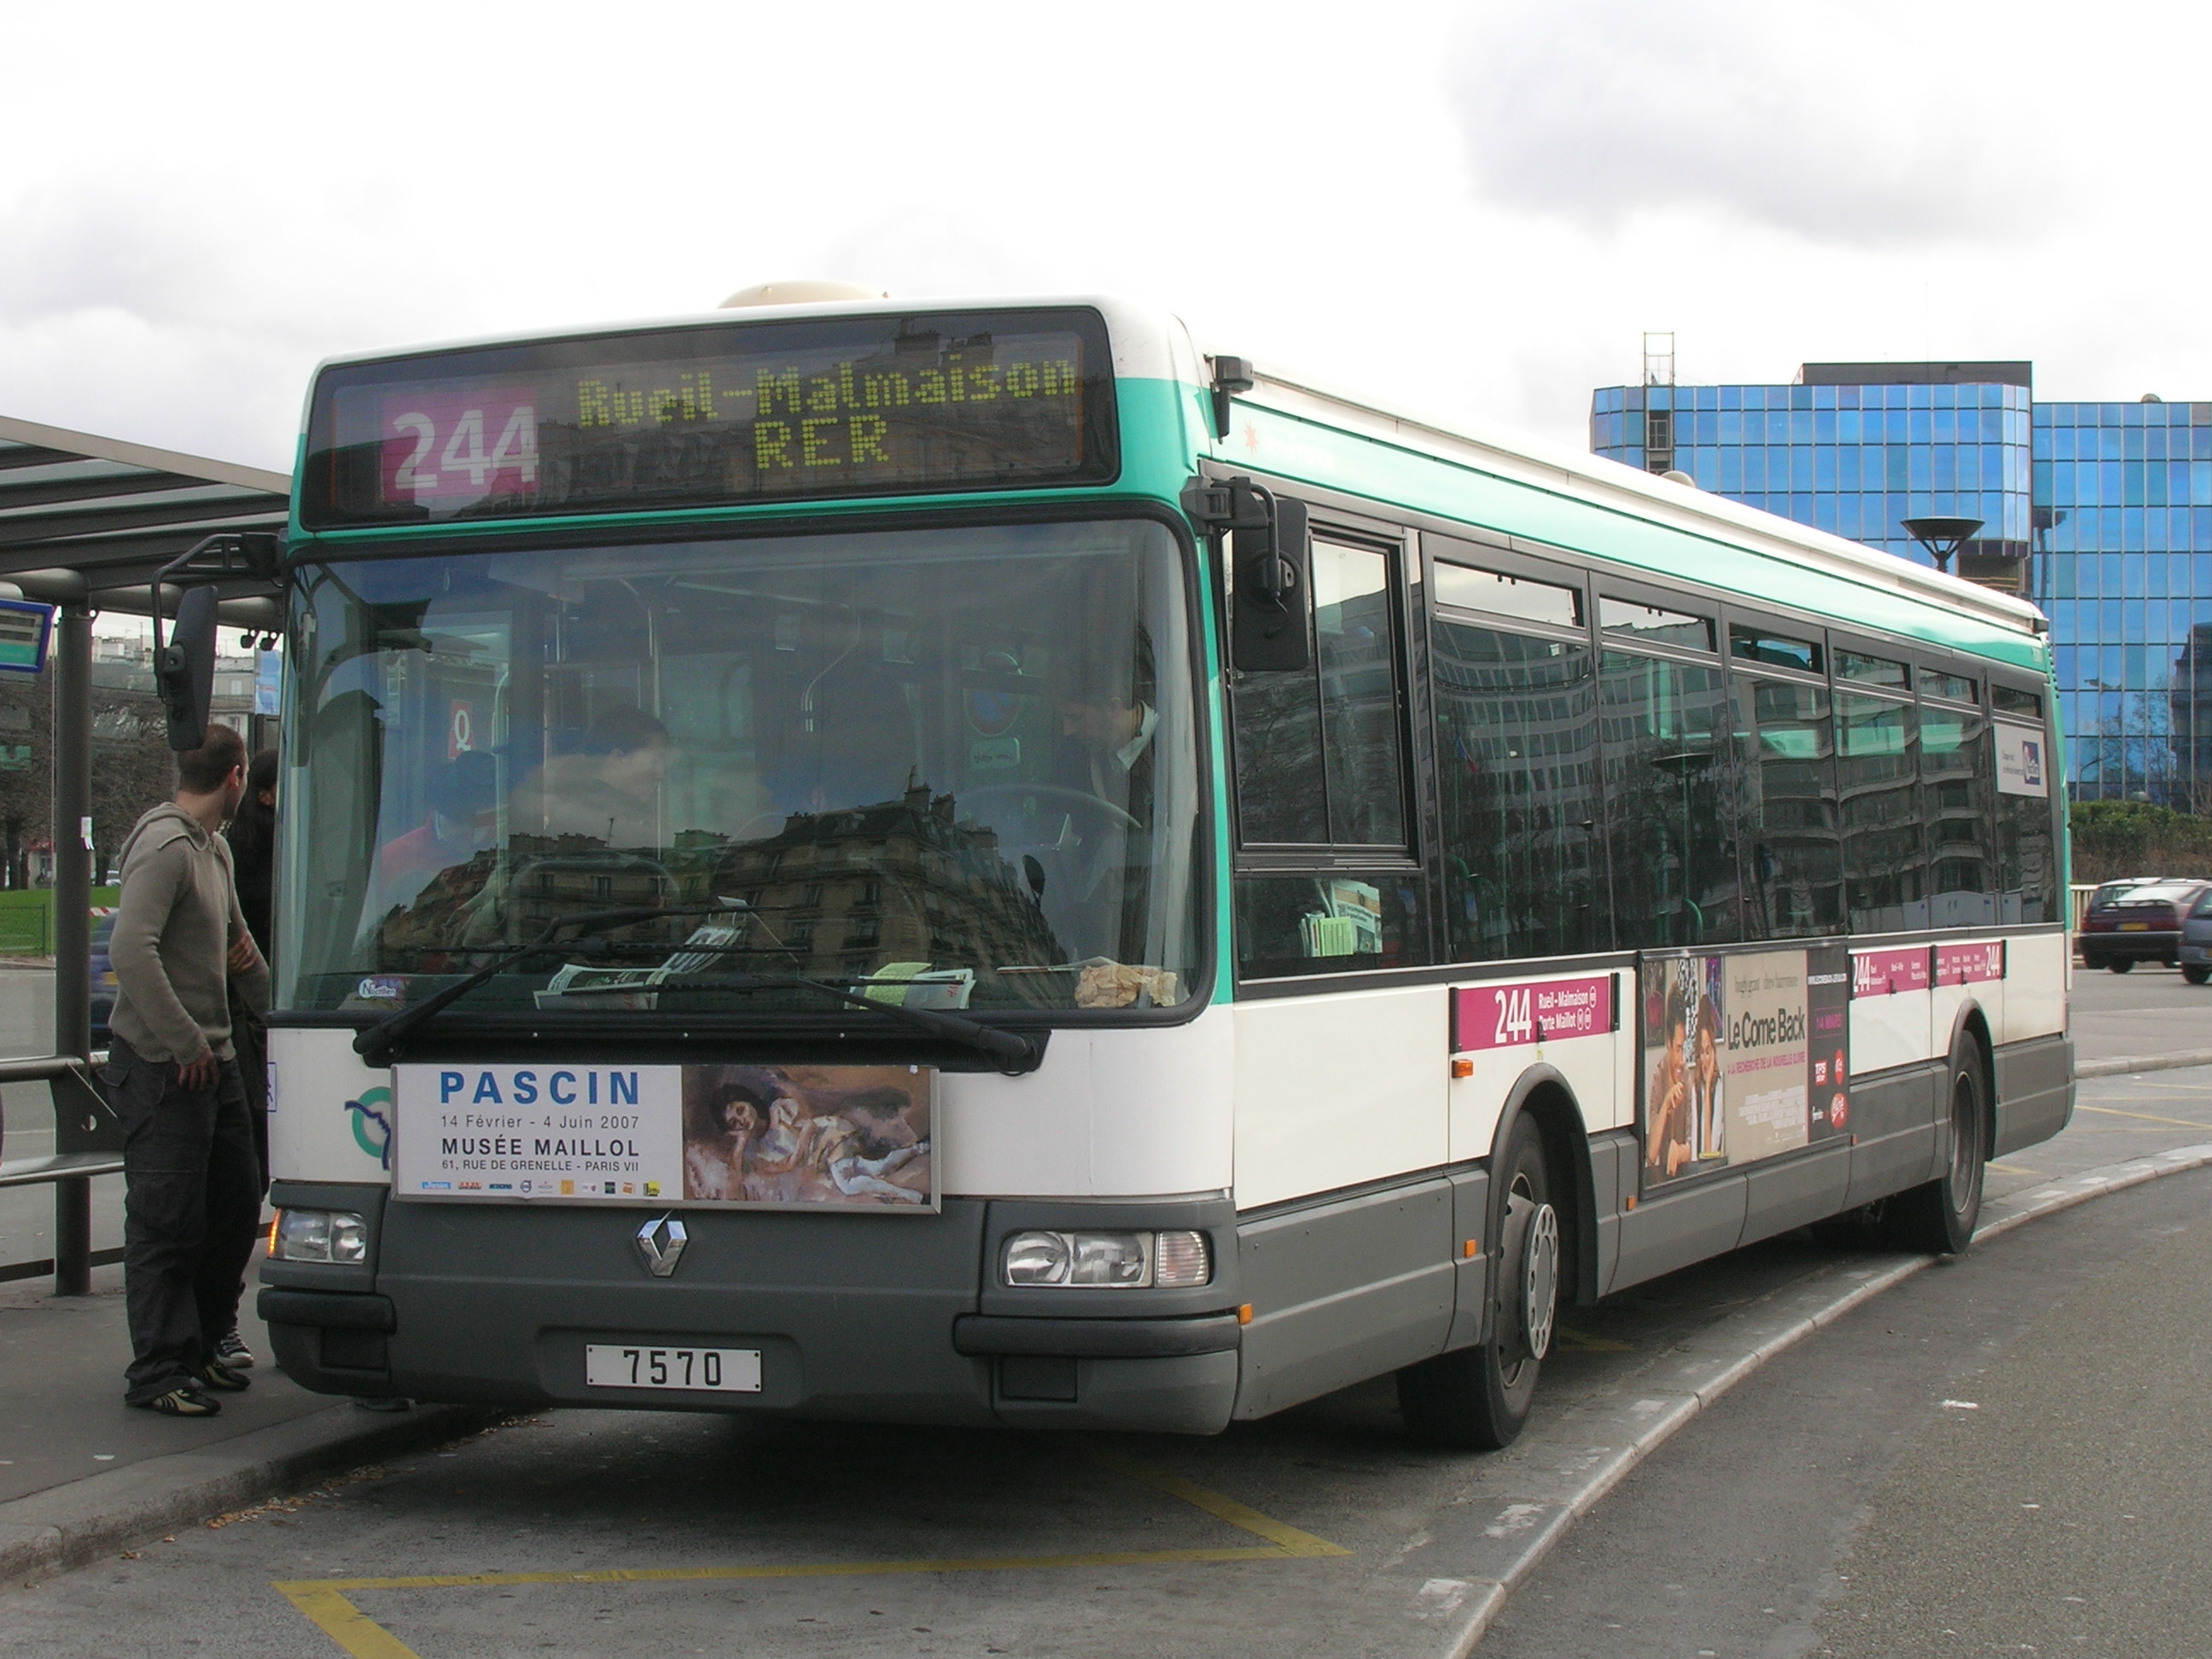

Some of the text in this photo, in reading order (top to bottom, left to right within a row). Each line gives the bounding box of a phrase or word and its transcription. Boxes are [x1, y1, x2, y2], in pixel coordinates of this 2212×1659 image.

[579, 353, 1075, 428] Rueil-Malmaison
[393, 406, 539, 490] 244
[754, 414, 889, 469] RER
[455, 709, 471, 751] Q
[1854, 955, 1870, 992] 244
[1986, 946, 2000, 977] 244
[1494, 988, 1532, 1044] 244
[1556, 1012, 1576, 1030] Maillot
[1727, 1006, 1806, 1051] Le Come Back
[440, 1071, 638, 1105] PASCIN
[441, 1115, 457, 1127] 14
[466, 1114, 521, 1128] Février
[544, 1115, 551, 1128] 4
[559, 1115, 593, 1129] Juin
[600, 1115, 639, 1129] 2007
[441, 1133, 639, 1157] MUSÉE MAILLOL
[441, 1159, 459, 1171] 61,
[463, 1159, 486, 1170] RUE
[490, 1159, 507, 1171] DE
[509, 1159, 573, 1172] GRENELLE
[585, 1161, 620, 1173] PARIS
[623, 1161, 639, 1173] VII
[624, 1349, 721, 1387] 7570
